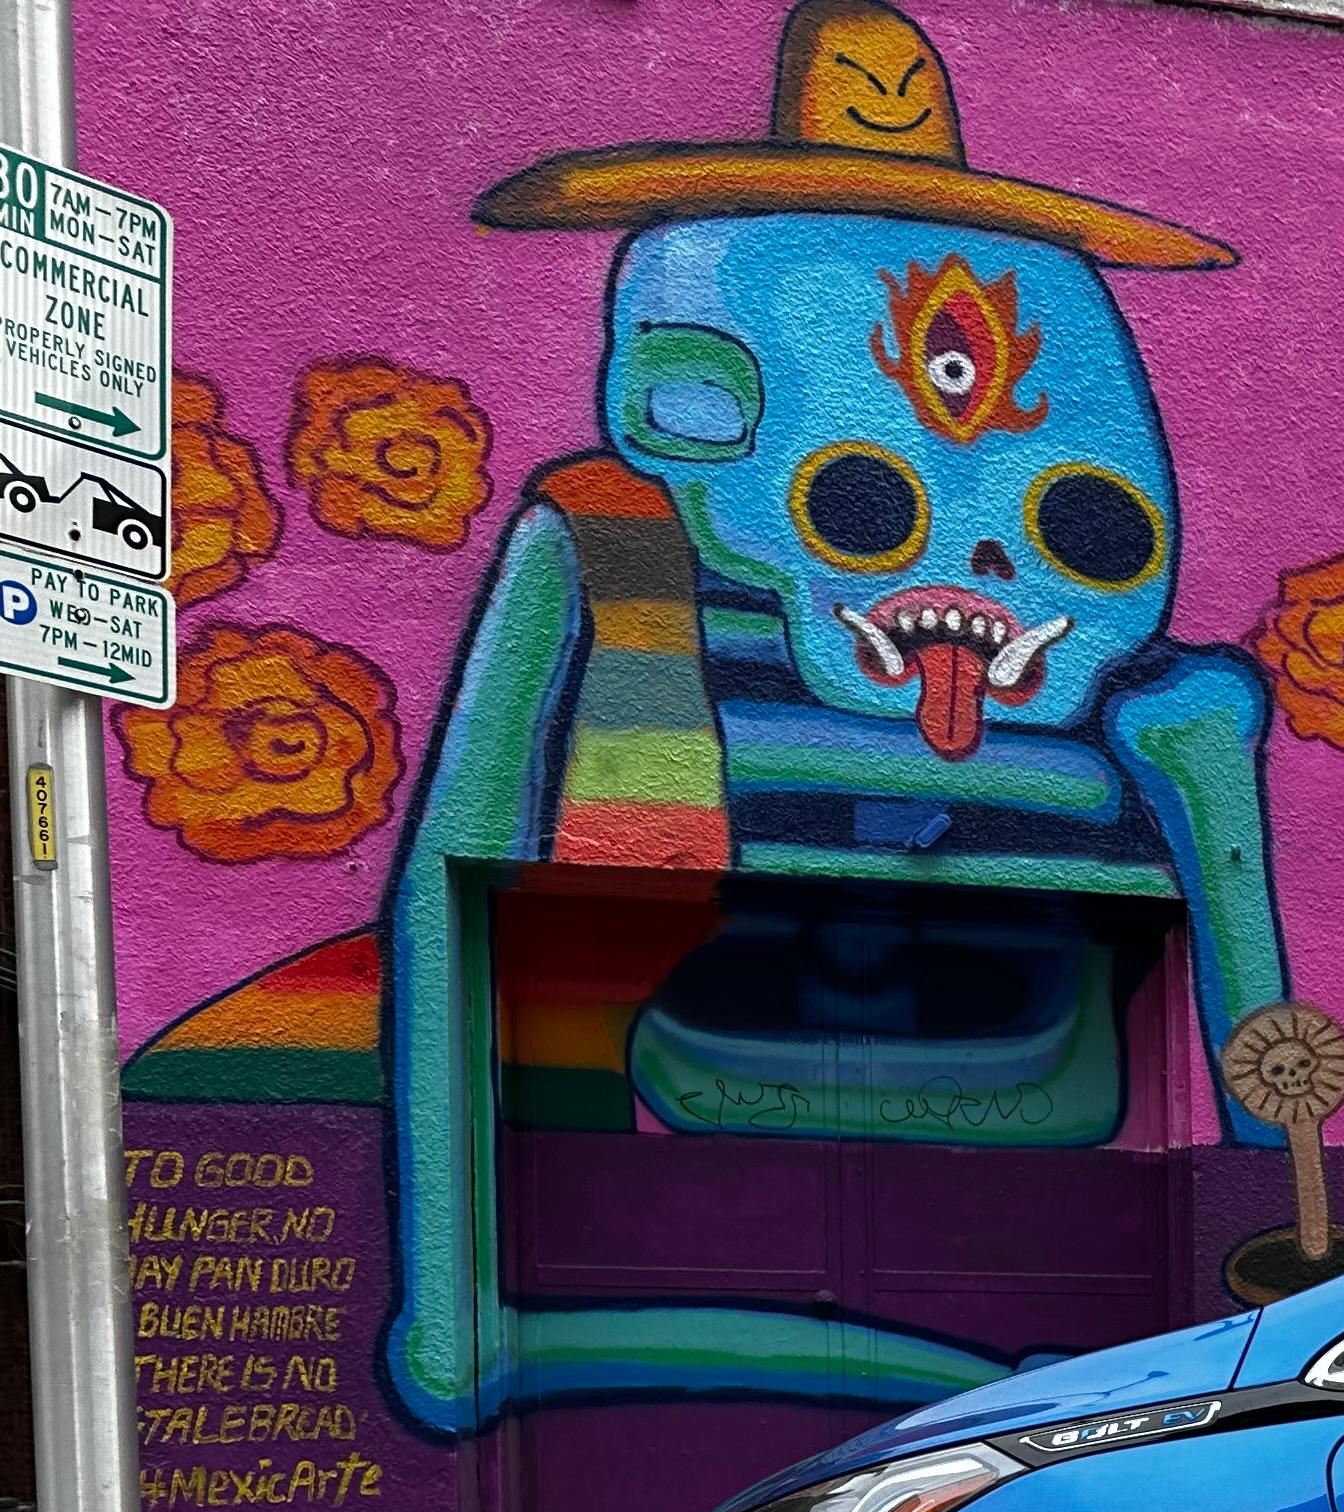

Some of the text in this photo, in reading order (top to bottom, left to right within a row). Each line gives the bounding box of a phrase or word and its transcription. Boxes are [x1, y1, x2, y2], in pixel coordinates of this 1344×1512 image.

[50, 182, 90, 217] 7AM
[116, 207, 156, 241] 7PM
[50, 209, 95, 245] MON
[118, 236, 155, 265] SAT
[0, 240, 149, 317] COMMERCIAL
[45, 295, 105, 341] ZONE
[0, 317, 156, 383] ROPERLY SIGNED
[6, 338, 144, 398] VEHICLES ONLY
[31, 567, 159, 617] PAY TO PARK
[50, 599, 91, 625] WED
[110, 616, 142, 639] SAT
[39, 624, 78, 650] 7PM
[103, 641, 152, 668] 12MID
[35, 776, 50, 855] 407661
[124, 1150, 315, 1189] TO GOOD
[188, 1255, 264, 1292] PAN
[269, 1256, 356, 1293] DURO
[138, 1301, 343, 1343] BUEN HAMBRE
[135, 1353, 338, 1395] THERE IS NO
[136, 1404, 247, 1445] TALE
[1051, 1408, 1204, 1446] BOLT EV
